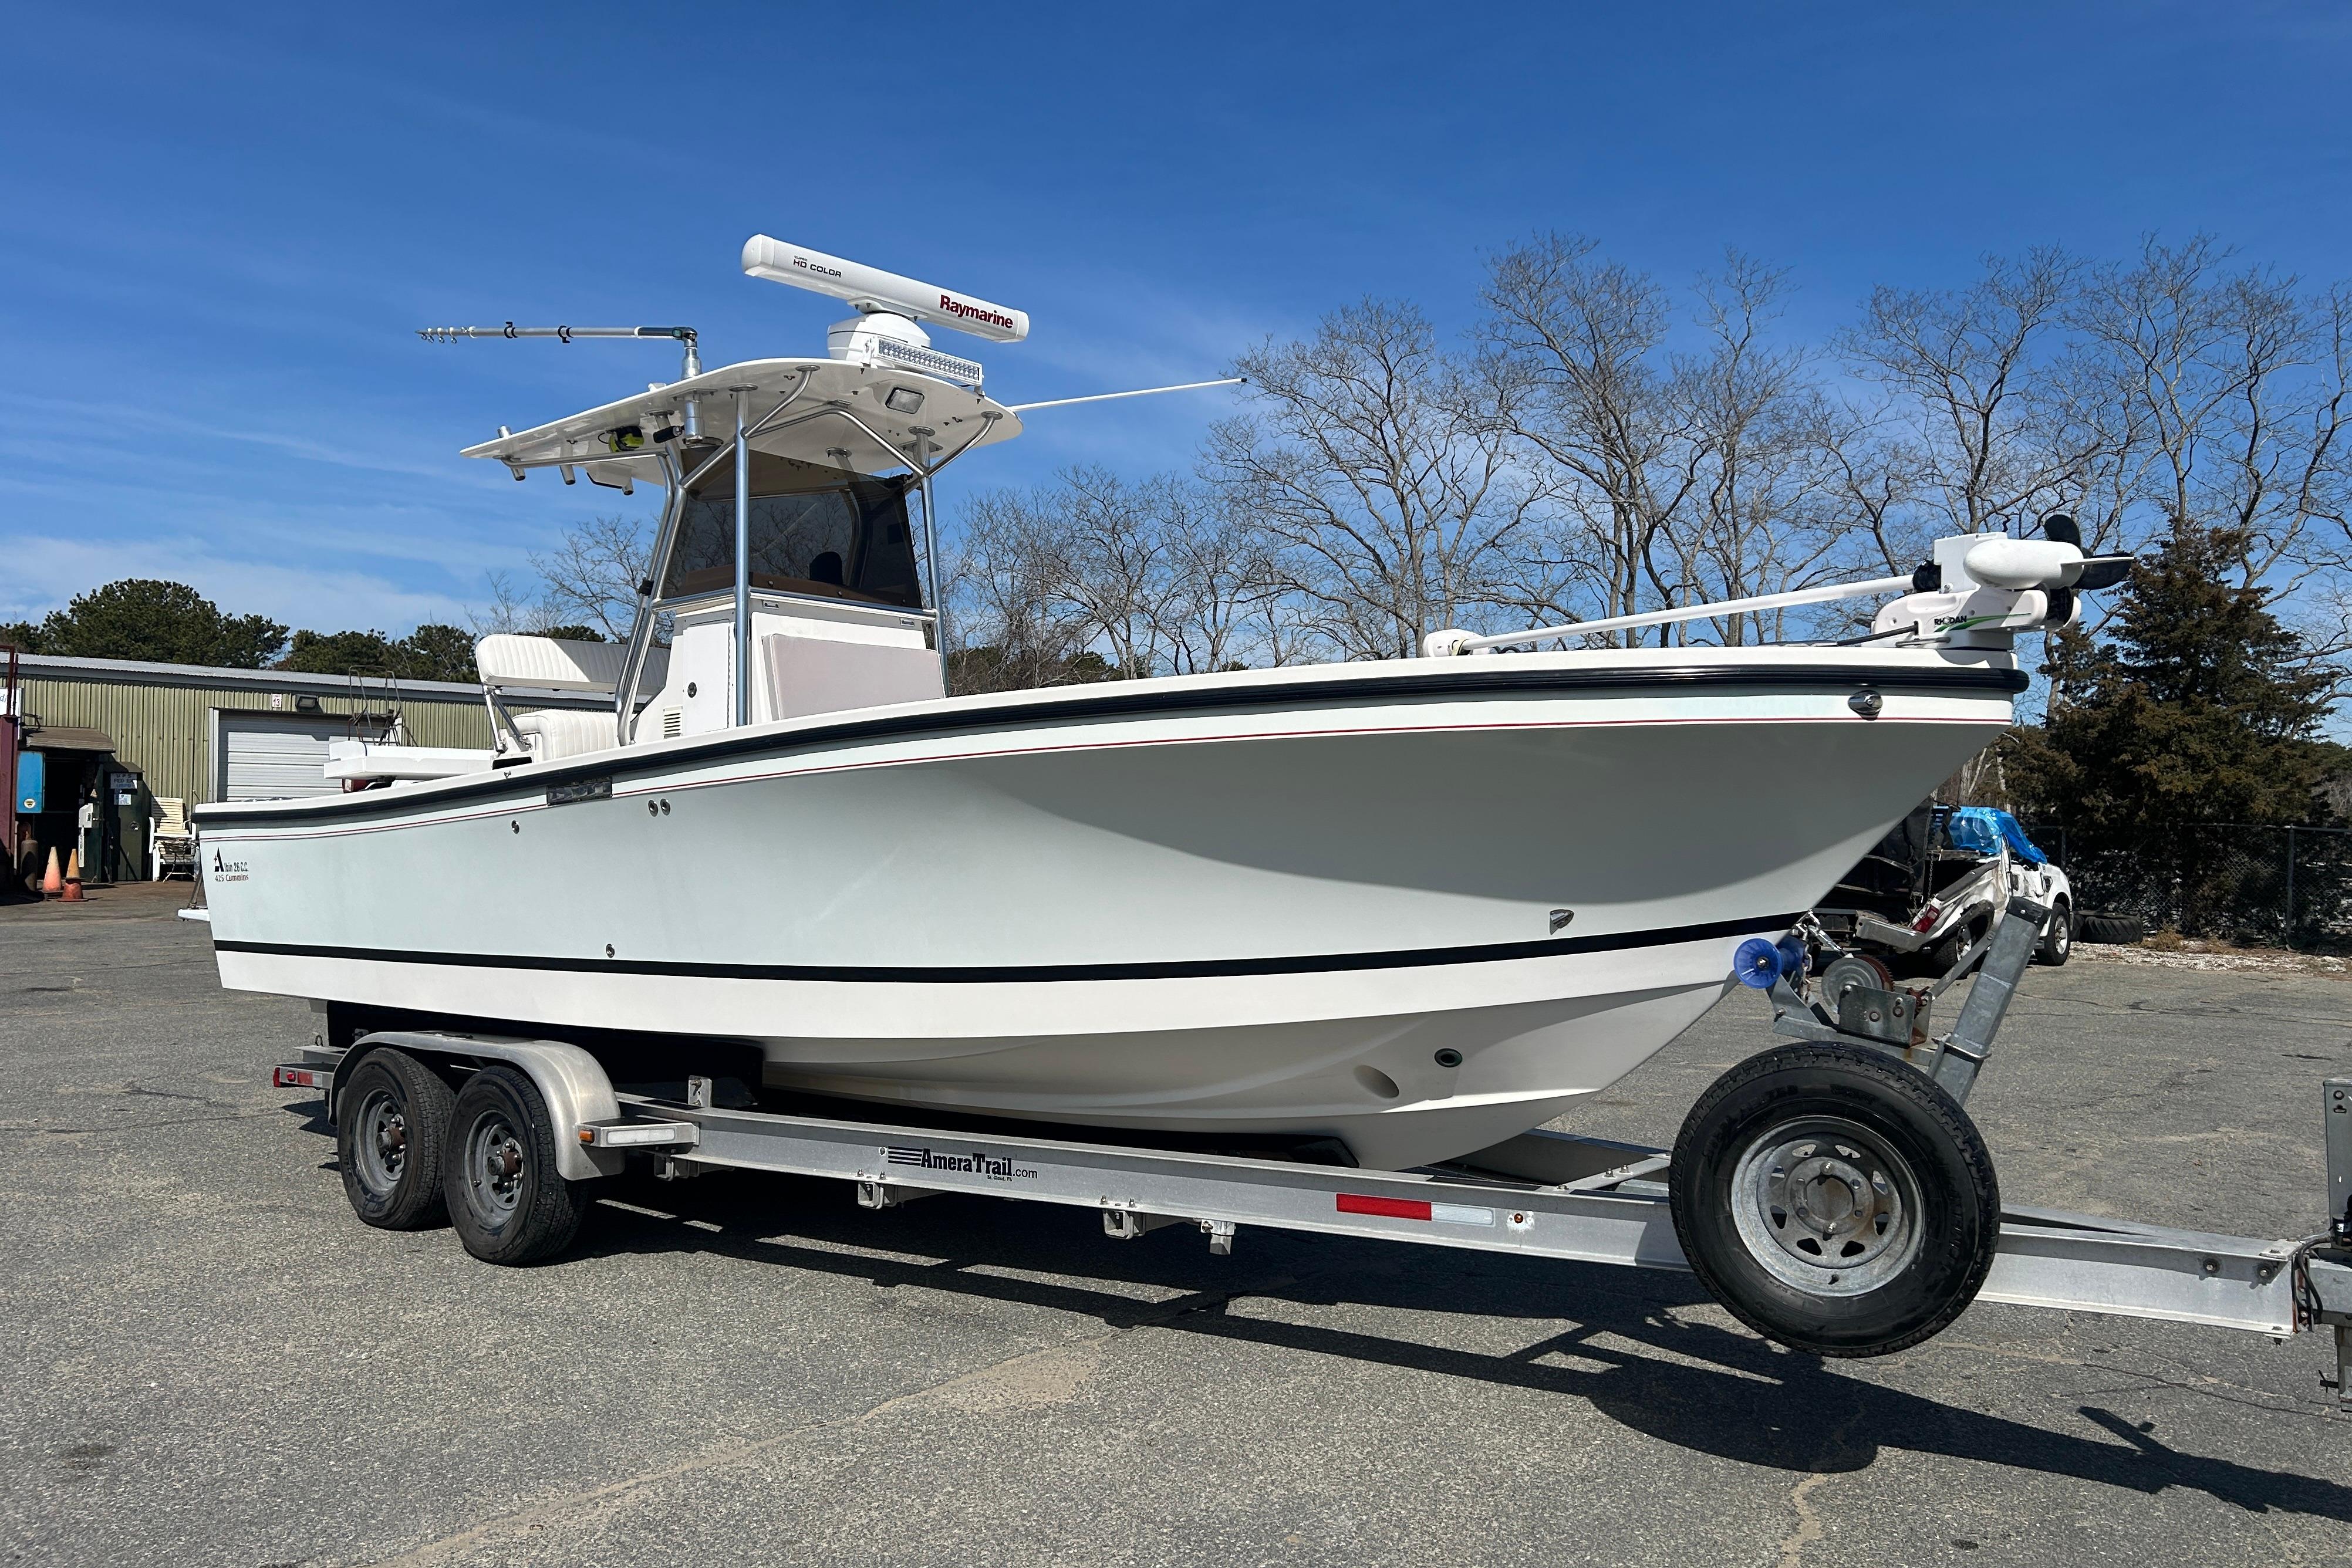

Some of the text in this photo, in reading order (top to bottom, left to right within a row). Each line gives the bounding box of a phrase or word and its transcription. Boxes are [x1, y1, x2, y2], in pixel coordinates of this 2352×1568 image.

[794, 259, 842, 278] HD COLOR
[940, 294, 1013, 329] Raymarine
[273, 698, 280, 707] 13
